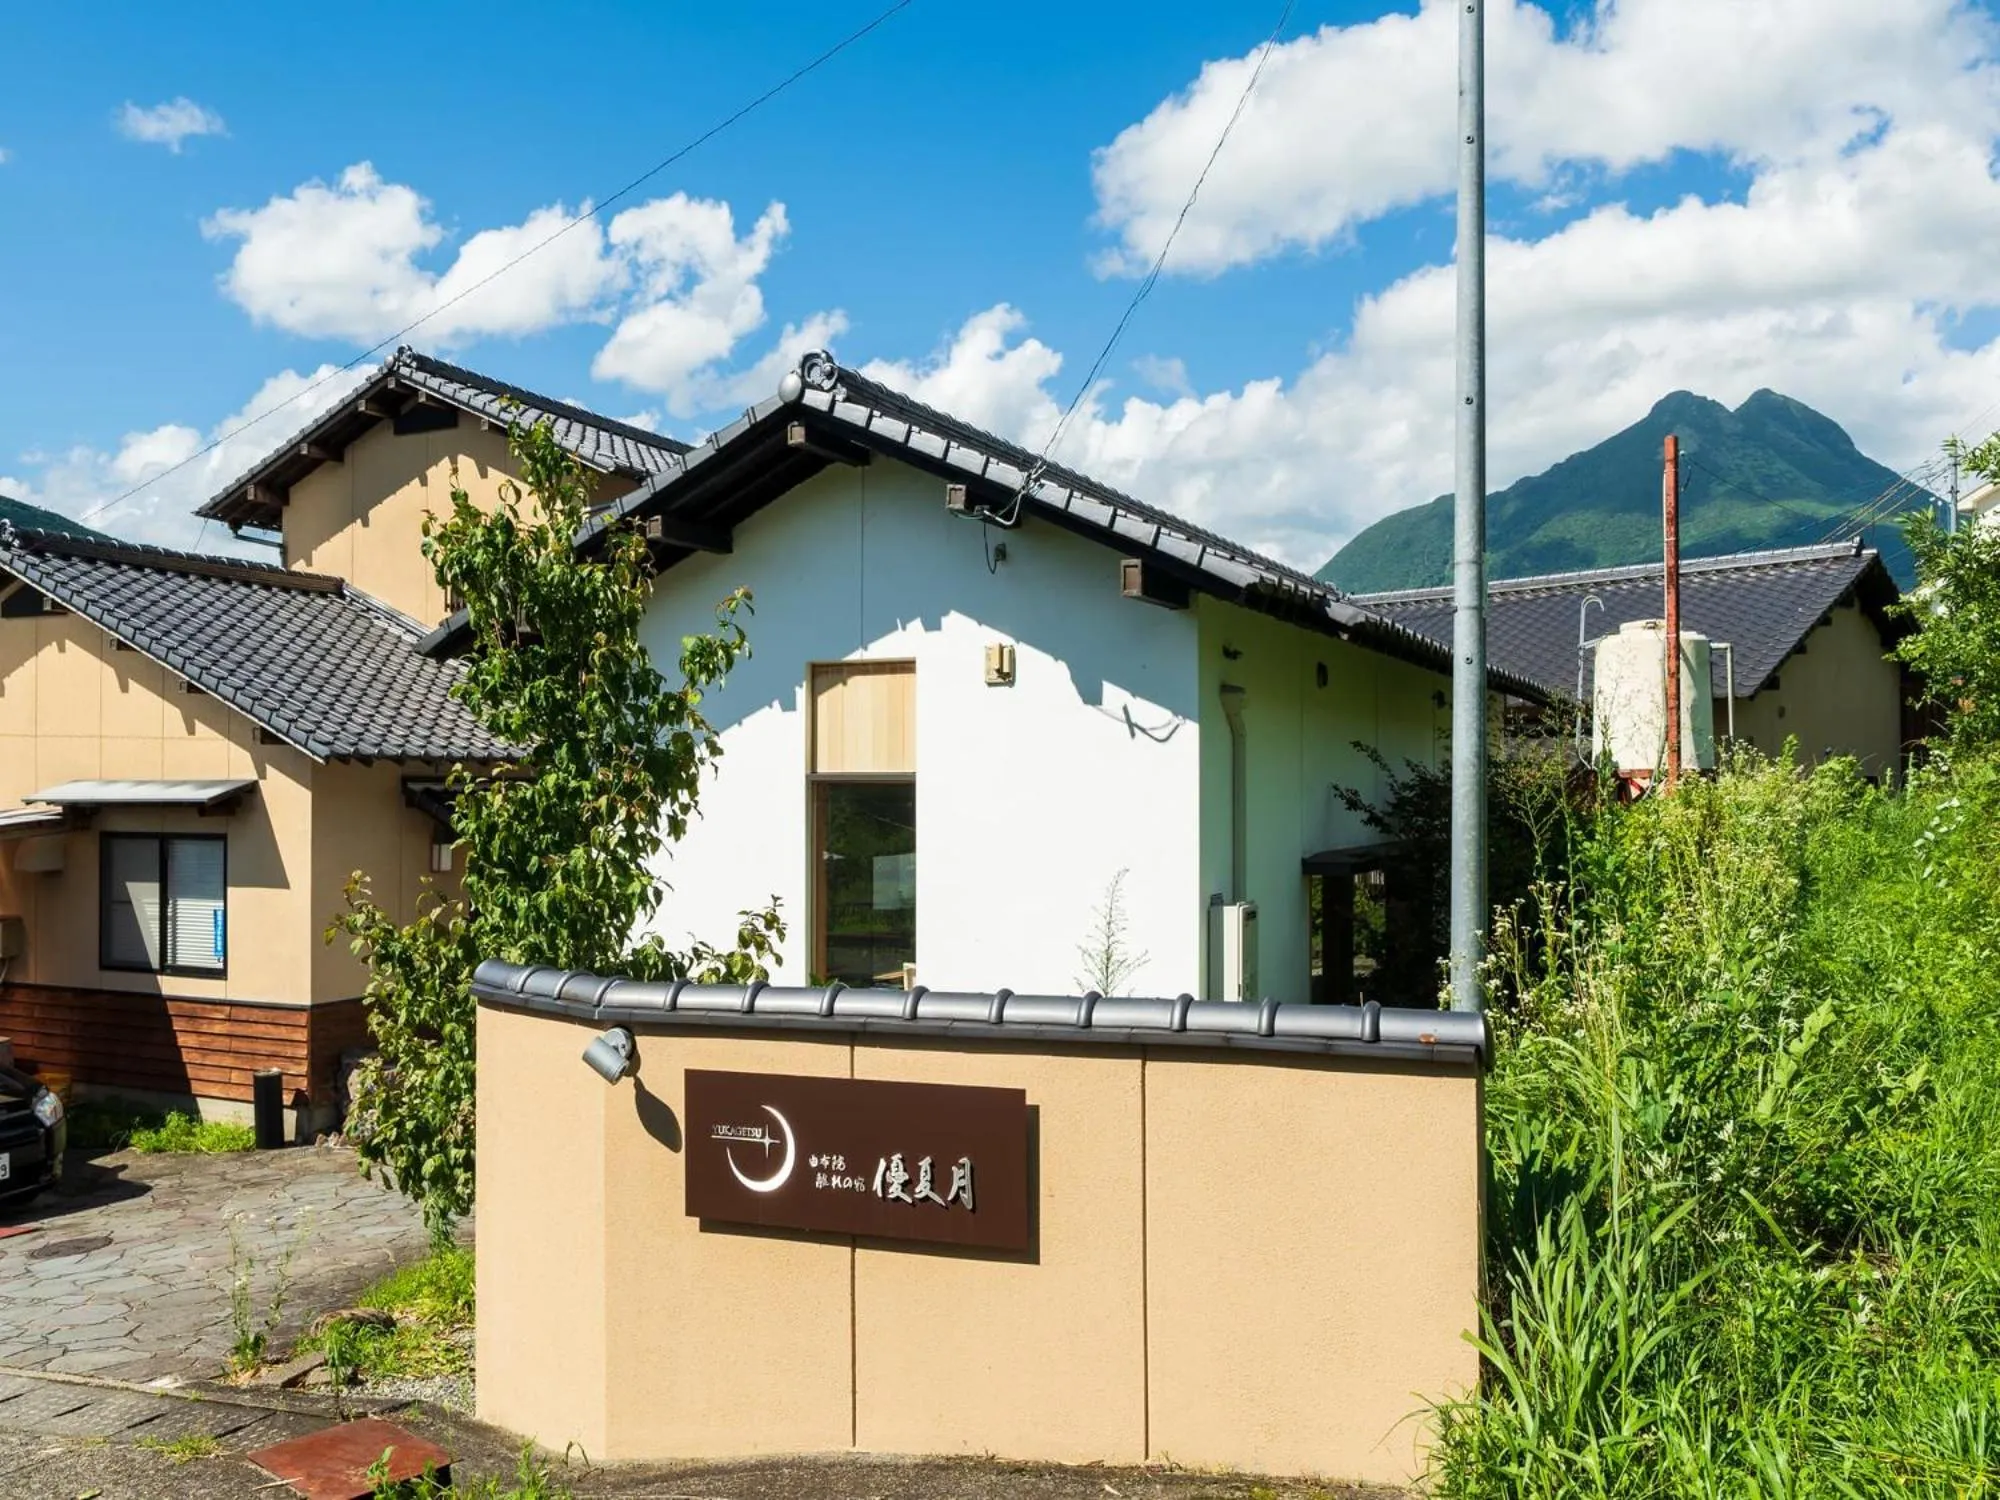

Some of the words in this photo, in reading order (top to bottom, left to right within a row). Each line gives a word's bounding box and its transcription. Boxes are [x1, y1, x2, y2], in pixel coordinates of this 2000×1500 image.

[712, 1124, 762, 1138] YUKAGETSU
[808, 1153, 846, 1171] 由布院
[815, 1172, 866, 1192] 離れの宿
[872, 1153, 973, 1210] 優夏月
